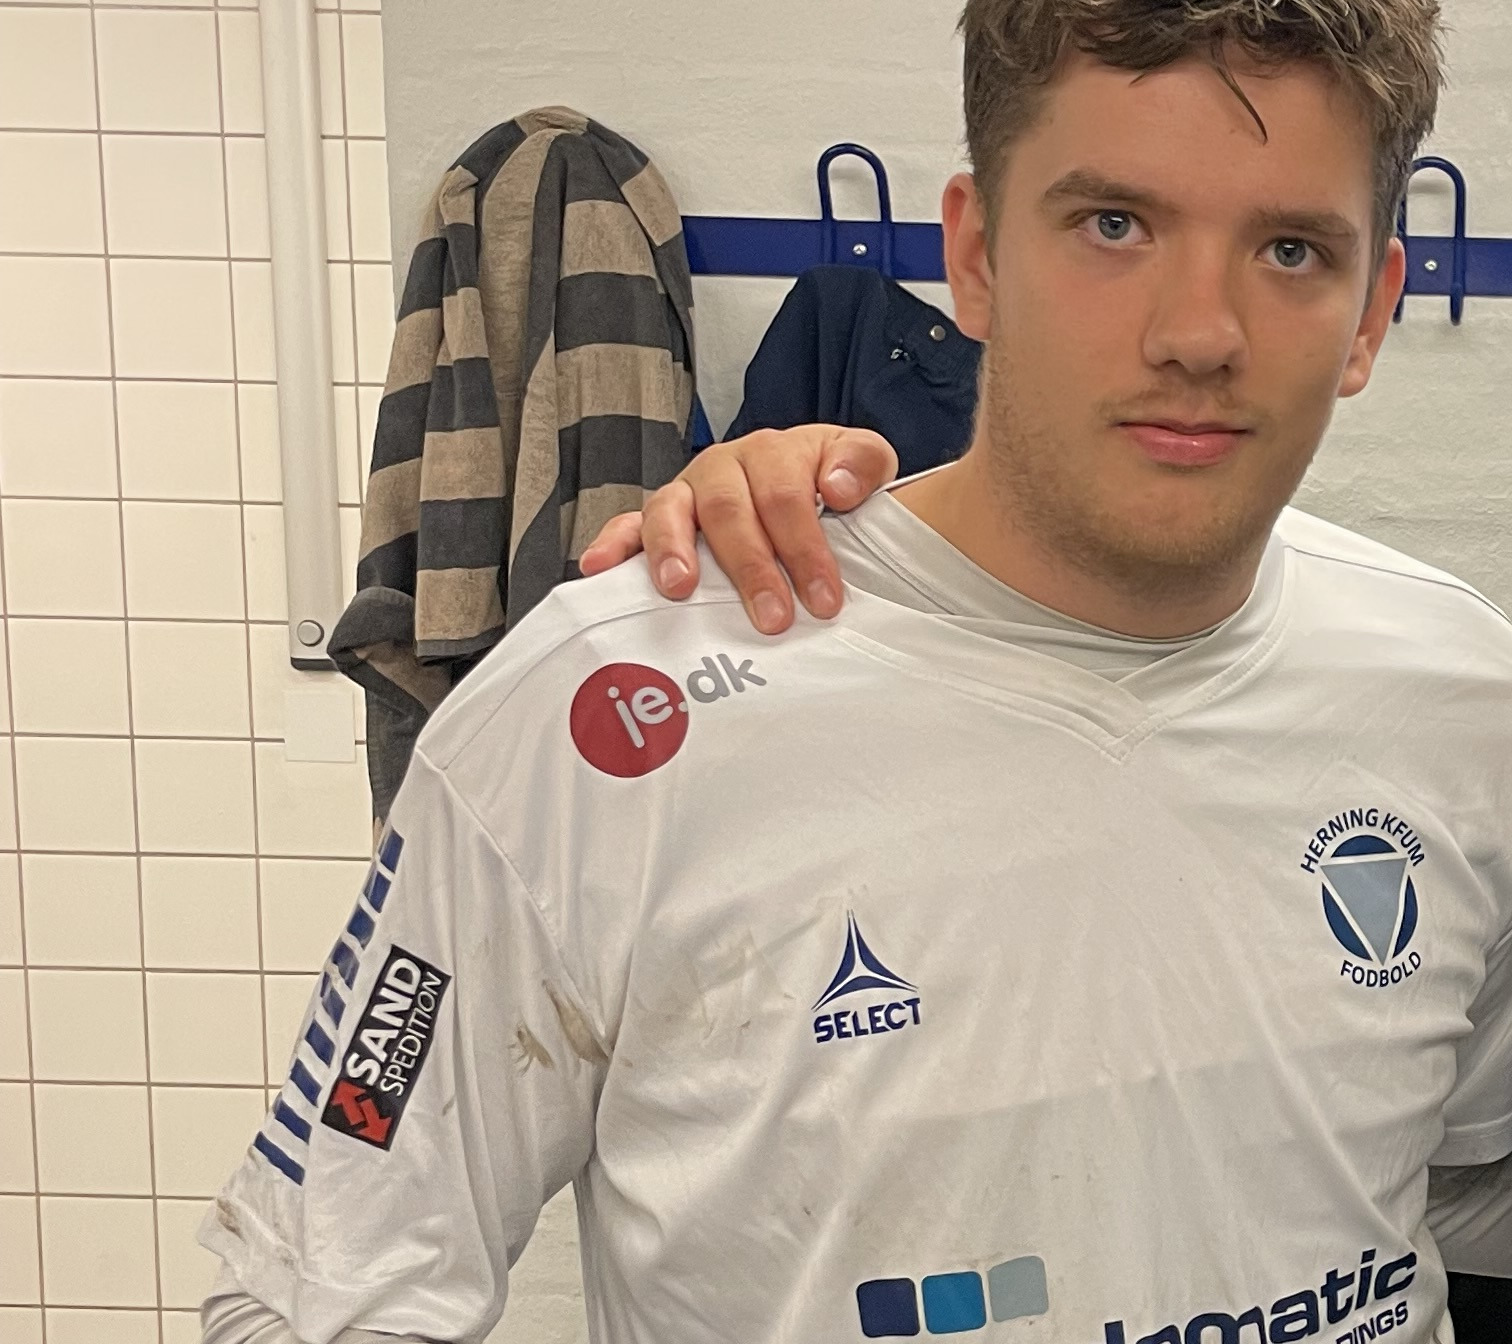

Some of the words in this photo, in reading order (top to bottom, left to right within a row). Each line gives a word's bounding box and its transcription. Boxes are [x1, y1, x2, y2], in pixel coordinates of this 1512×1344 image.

[1300, 808, 1379, 873] HERNING
[1380, 812, 1425, 867] KFUM
[1340, 951, 1422, 988] FODBOLD
[346, 957, 422, 1086] SAND
[380, 971, 443, 1097] SPEDITION
[813, 997, 921, 1044] SELECT
